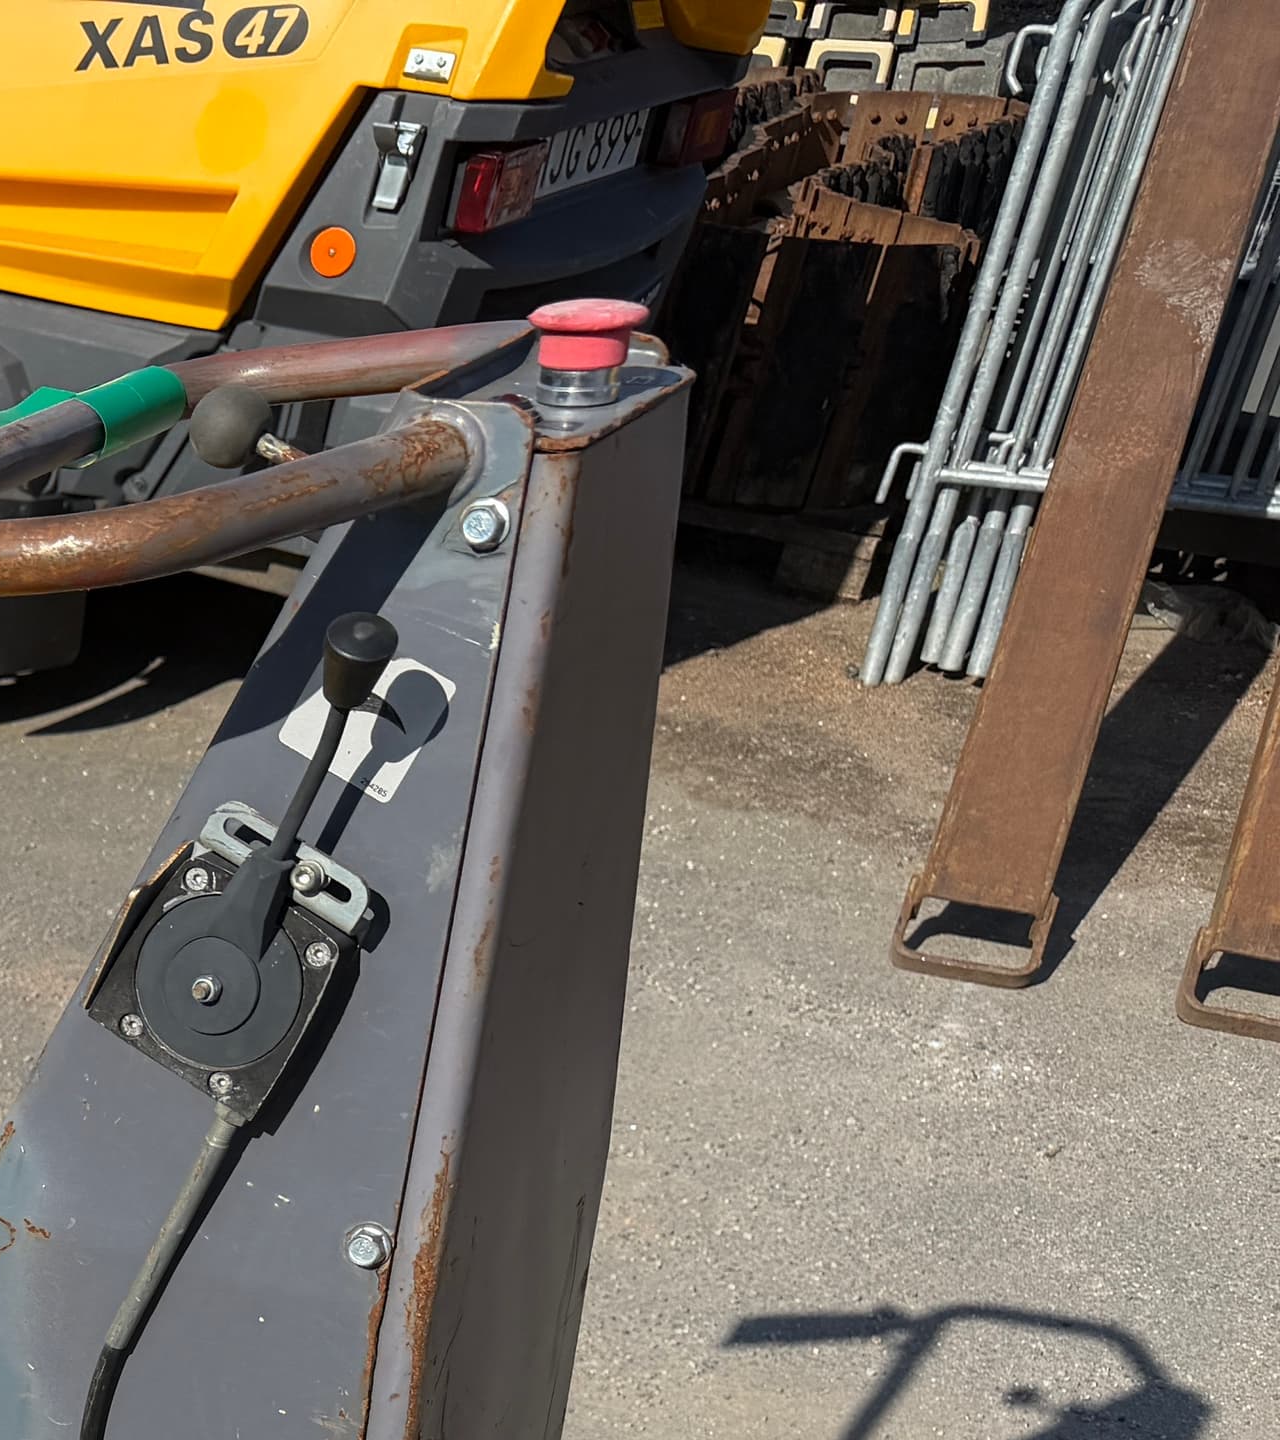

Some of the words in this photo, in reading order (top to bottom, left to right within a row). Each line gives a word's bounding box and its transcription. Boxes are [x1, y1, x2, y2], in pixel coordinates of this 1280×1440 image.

[74, 11, 214, 71] XAS
[235, 8, 300, 54] 47
[539, 125, 586, 188] JG
[587, 111, 639, 173] 899
